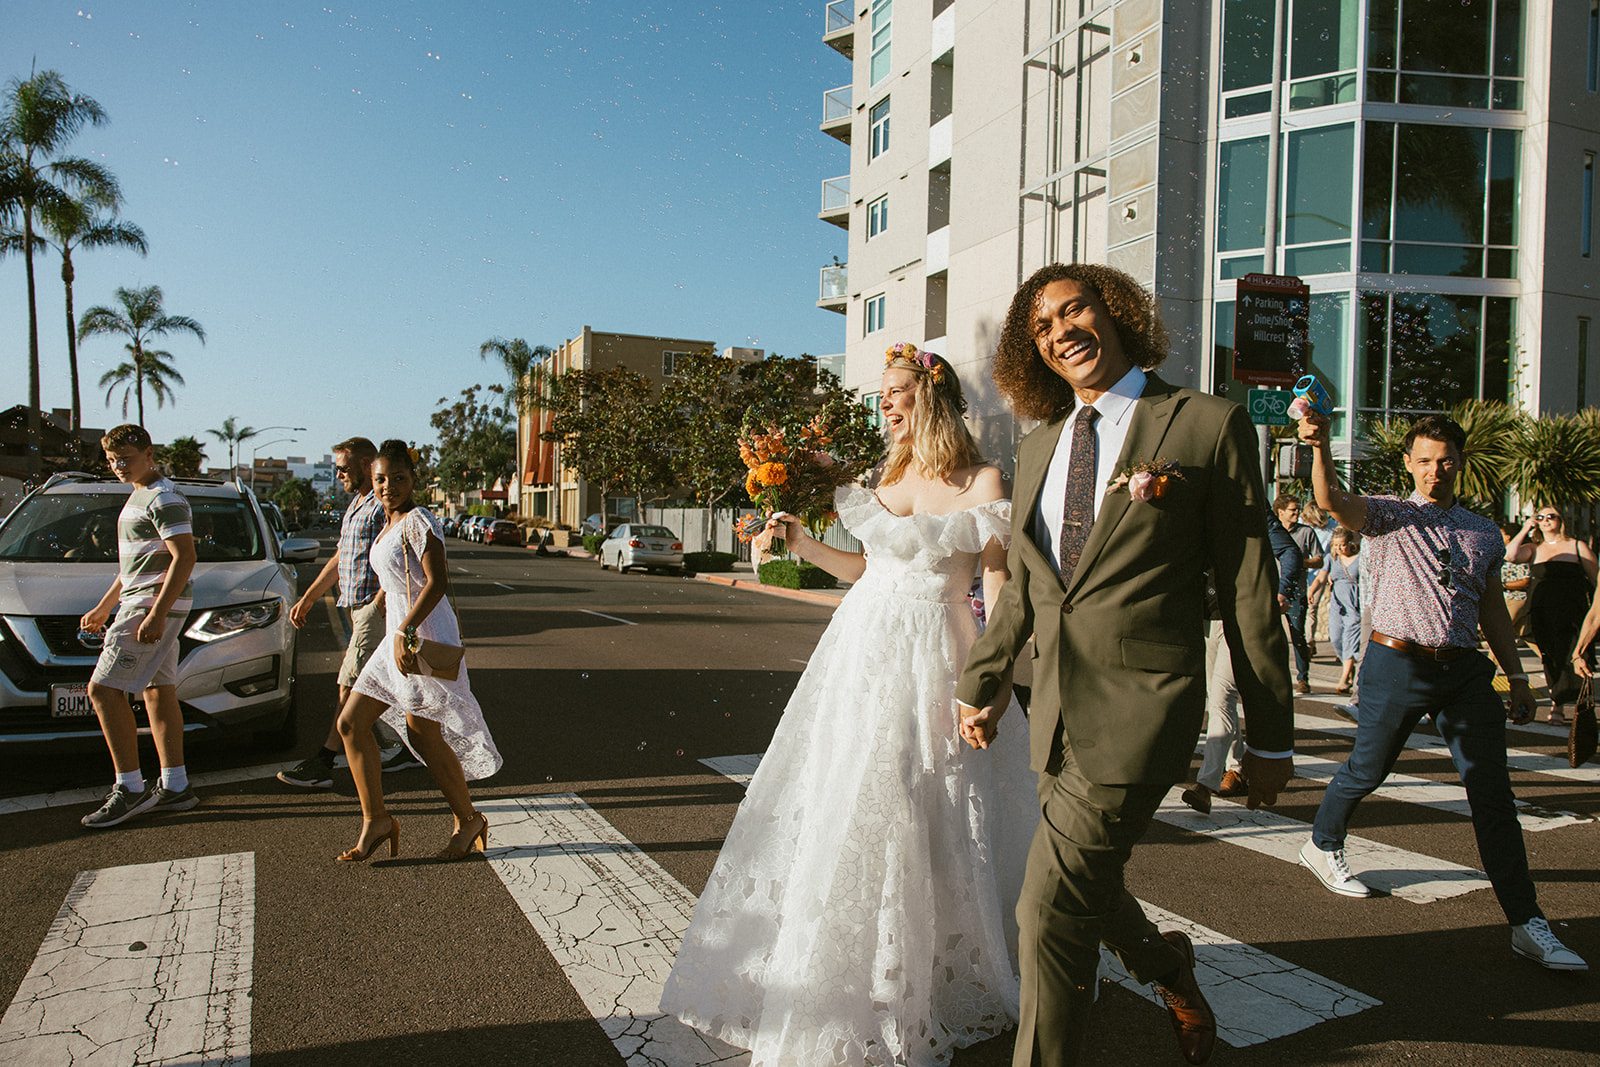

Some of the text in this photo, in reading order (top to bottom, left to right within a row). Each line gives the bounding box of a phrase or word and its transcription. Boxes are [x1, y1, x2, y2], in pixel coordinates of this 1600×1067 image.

[1255, 297, 1284, 312] Parking
[1254, 313, 1293, 329] Dine/Shop
[1254, 330, 1285, 343] Hillcrest
[1251, 415, 1265, 424] BIKE
[58, 696, 93, 712] 8UMV
